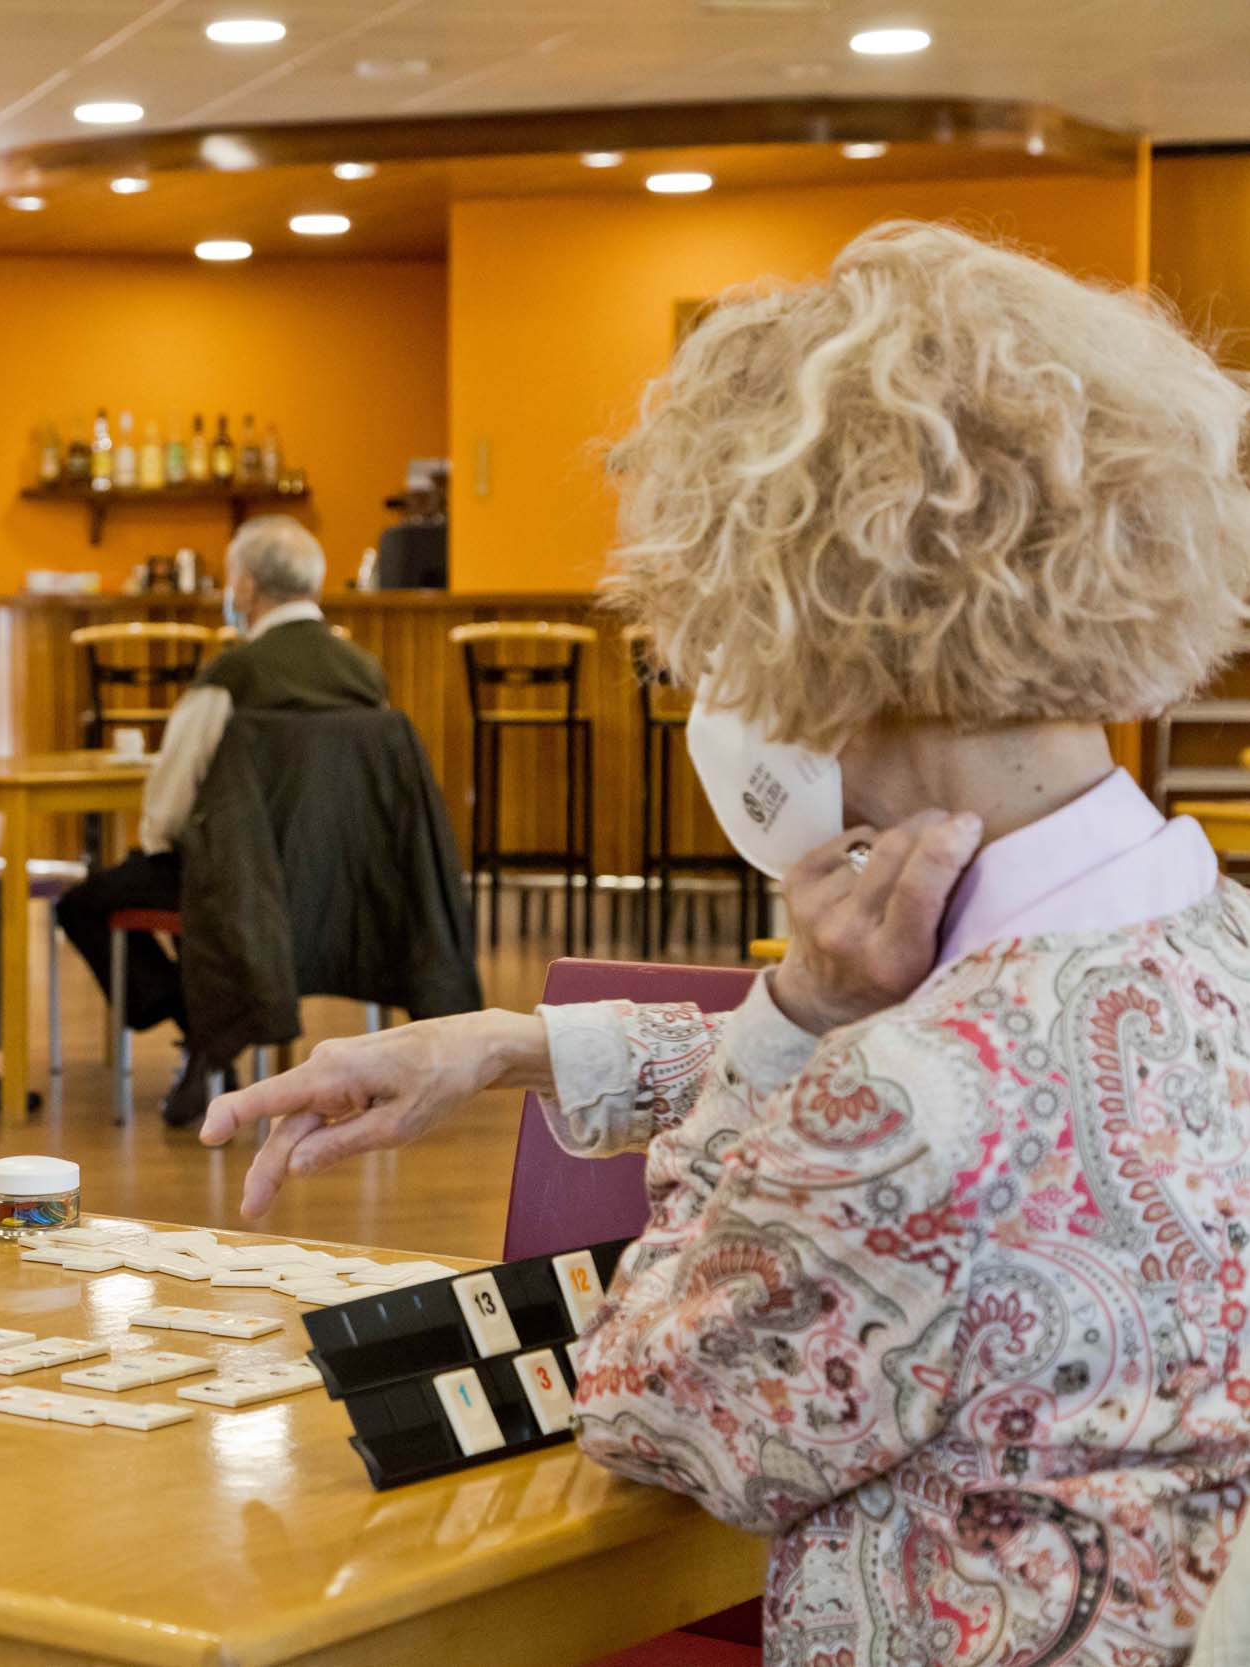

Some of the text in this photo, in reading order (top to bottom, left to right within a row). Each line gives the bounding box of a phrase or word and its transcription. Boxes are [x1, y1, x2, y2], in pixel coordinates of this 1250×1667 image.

[569, 1267, 591, 1292] 12
[474, 1291, 496, 1316] 13
[536, 1366, 552, 1390] 3
[458, 1383, 472, 1408] 1
